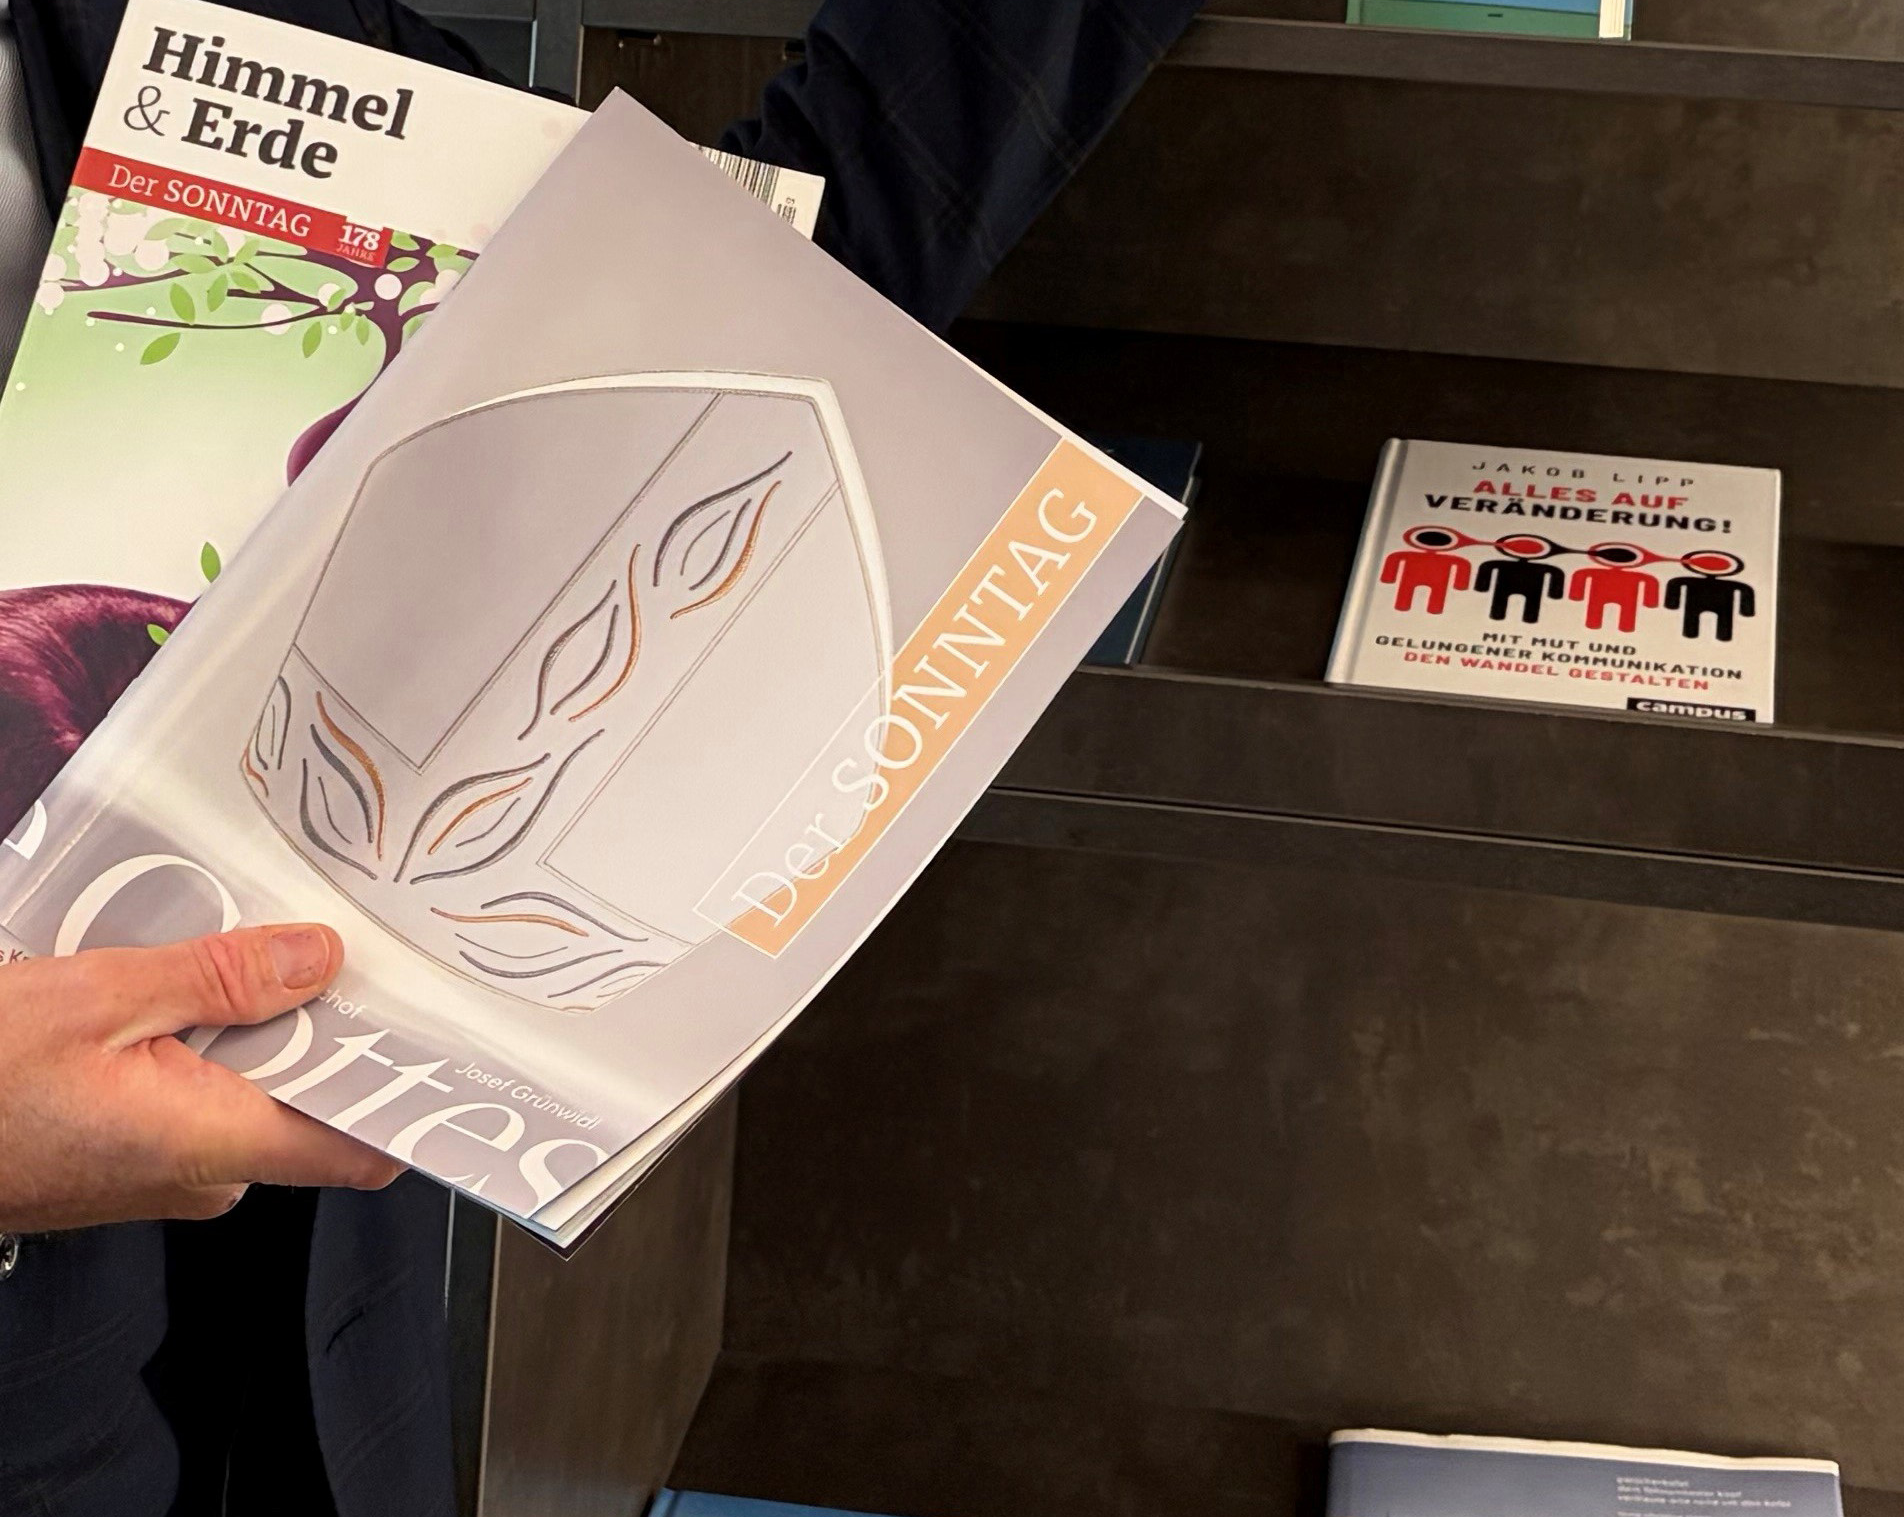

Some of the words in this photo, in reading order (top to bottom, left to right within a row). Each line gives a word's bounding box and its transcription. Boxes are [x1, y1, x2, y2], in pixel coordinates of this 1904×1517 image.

[141, 26, 414, 140] Himmel
[123, 85, 170, 137] &
[180, 97, 338, 179] Erde
[108, 163, 160, 197] Der
[163, 179, 312, 238] SONNTAG
[335, 244, 377, 262] JAHRE
[340, 222, 382, 252] 178
[1472, 461, 1587, 480] JAKOB
[1613, 472, 1695, 487] LIPP
[1424, 492, 1733, 534] VERÄNDERUNG!
[1472, 480, 1597, 504] ALLES
[1611, 491, 1689, 510] AUF
[1375, 635, 1532, 661] GELUNGENER
[1541, 651, 1743, 681] KOMMUNIKATION
[1482, 632, 1524, 646] MIT
[1531, 636, 1581, 652] MUT
[1589, 642, 1638, 657] UND
[1404, 651, 1450, 665] DEN
[1460, 656, 1559, 676] WANDEL
[1569, 667, 1709, 691] GESTALTEN
[730, 810, 847, 926] Der
[830, 486, 1099, 813] SONNTAG
[1635, 699, 1747, 721] campus
[454, 1061, 516, 1093] Josef
[510, 1084, 603, 1133] Grünwidl
